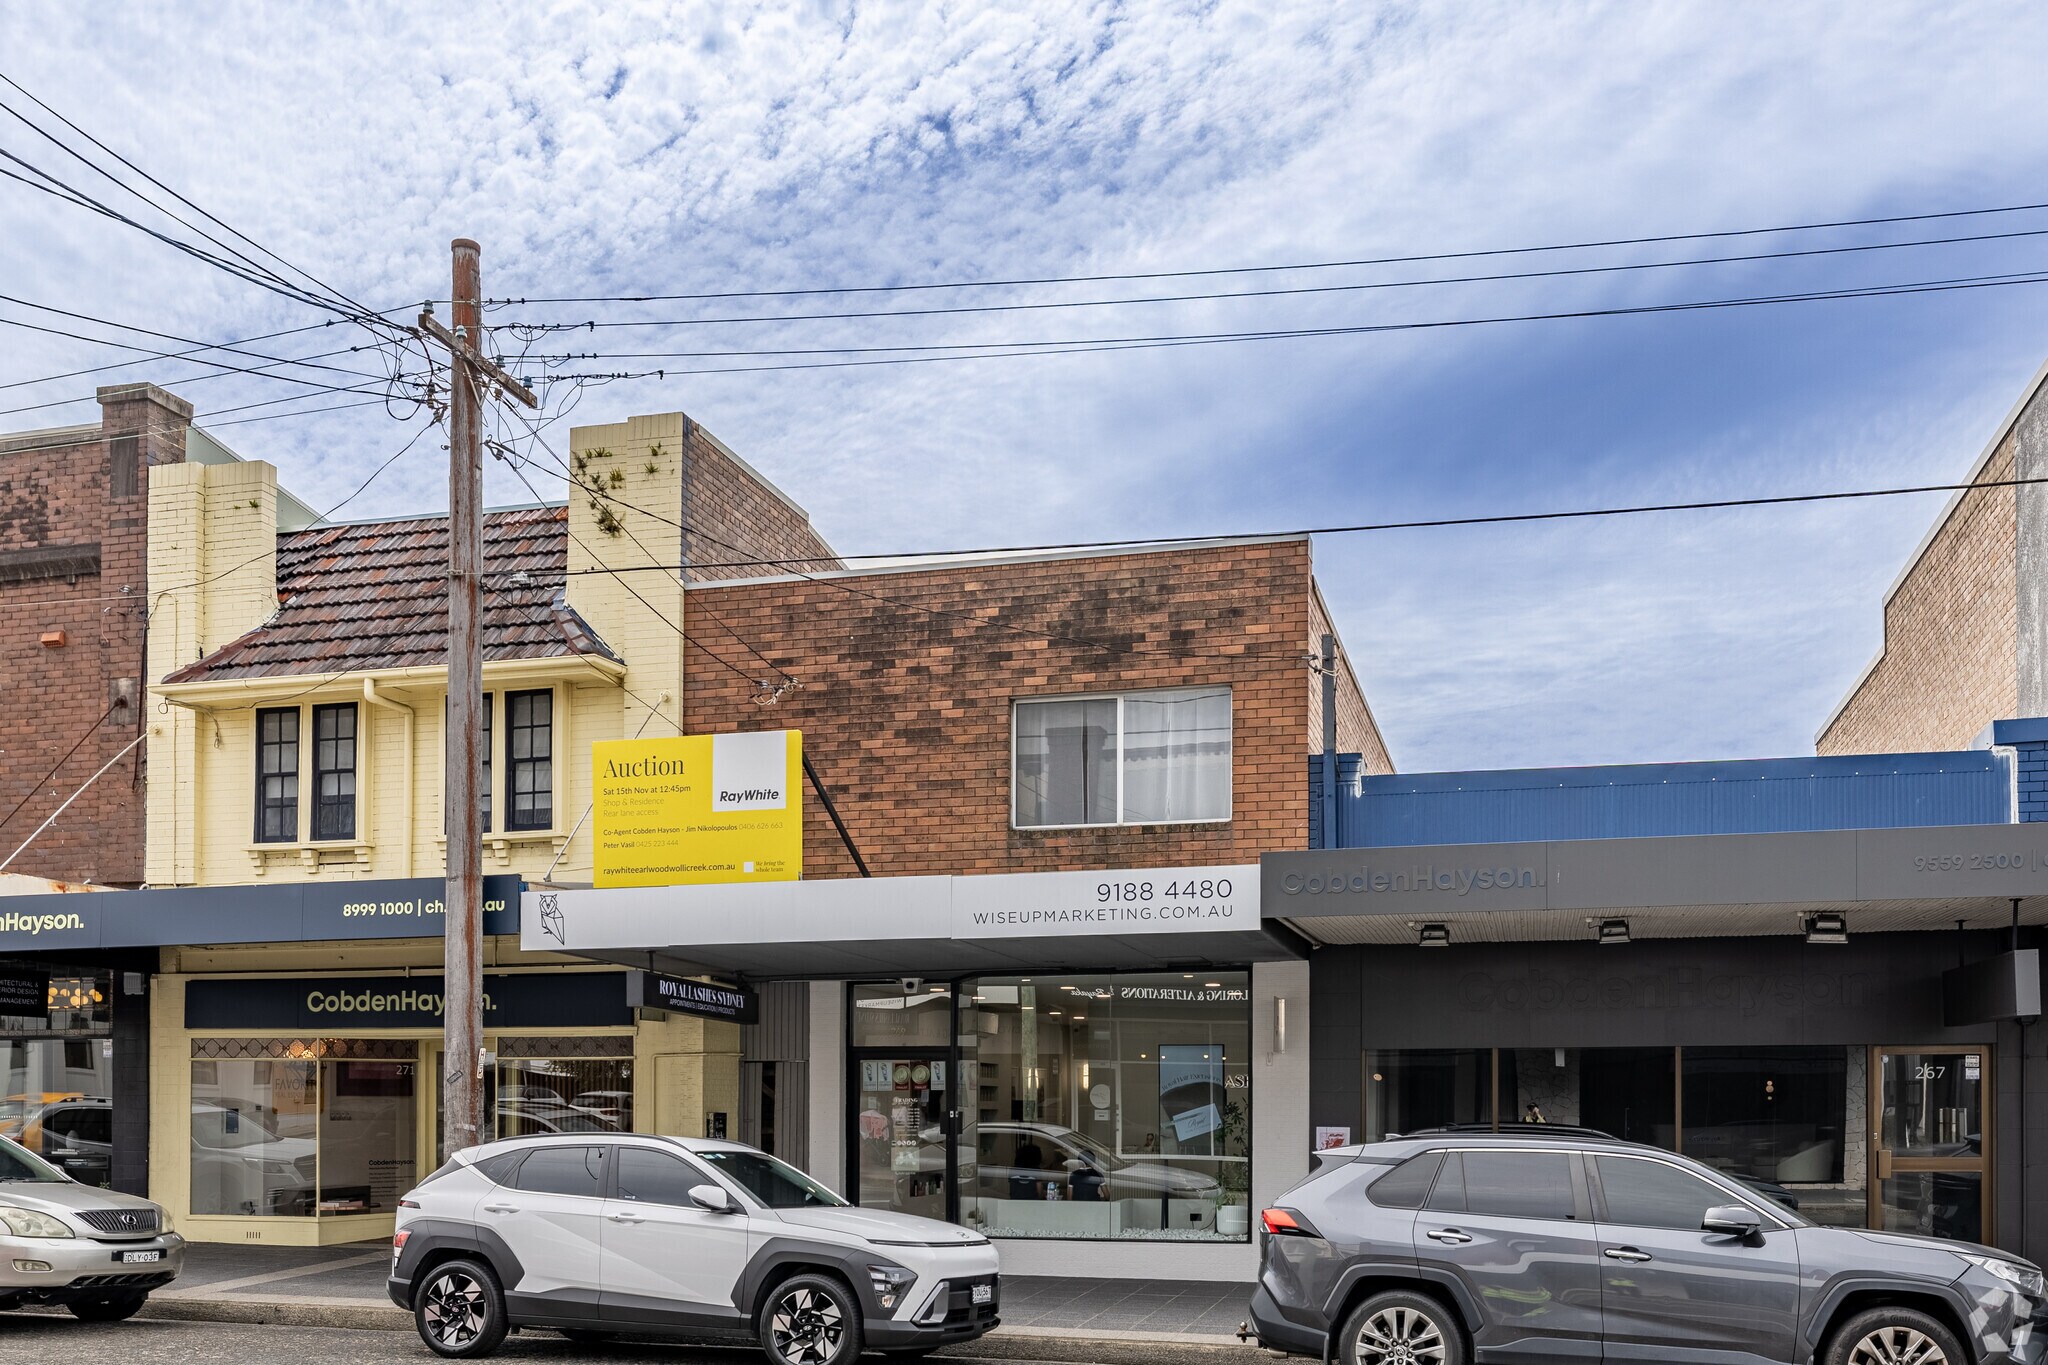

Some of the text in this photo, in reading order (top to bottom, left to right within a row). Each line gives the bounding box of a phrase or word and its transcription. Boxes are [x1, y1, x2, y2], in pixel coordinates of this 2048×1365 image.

[603, 756, 685, 778] Auction
[603, 788, 614, 796] Sat
[617, 787, 632, 795] 15th
[660, 785, 691, 793] 12:45pm
[603, 799, 620, 808] Shop
[630, 798, 664, 806] Residence
[658, 826, 680, 834] Hayson
[698, 824, 738, 832] Nikolopoulos
[603, 864, 736, 876] raywhiteearlwoodwollicreek.com.au
[1914, 854, 1965, 872] 9559
[1970, 852, 2024, 870] 2500
[1097, 879, 1233, 903] 9188 4480
[343, 903, 377, 917] 8999
[381, 901, 414, 916] 1000
[973, 904, 1233, 925] WISEUPMARKETING.COM.AU
[660, 980, 745, 1008] ROYAL LASHES SYDNEY
[307, 990, 497, 1016] CobdenHayn.
[396, 1065, 415, 1076] 271
[1915, 1066, 1946, 1080] 267
